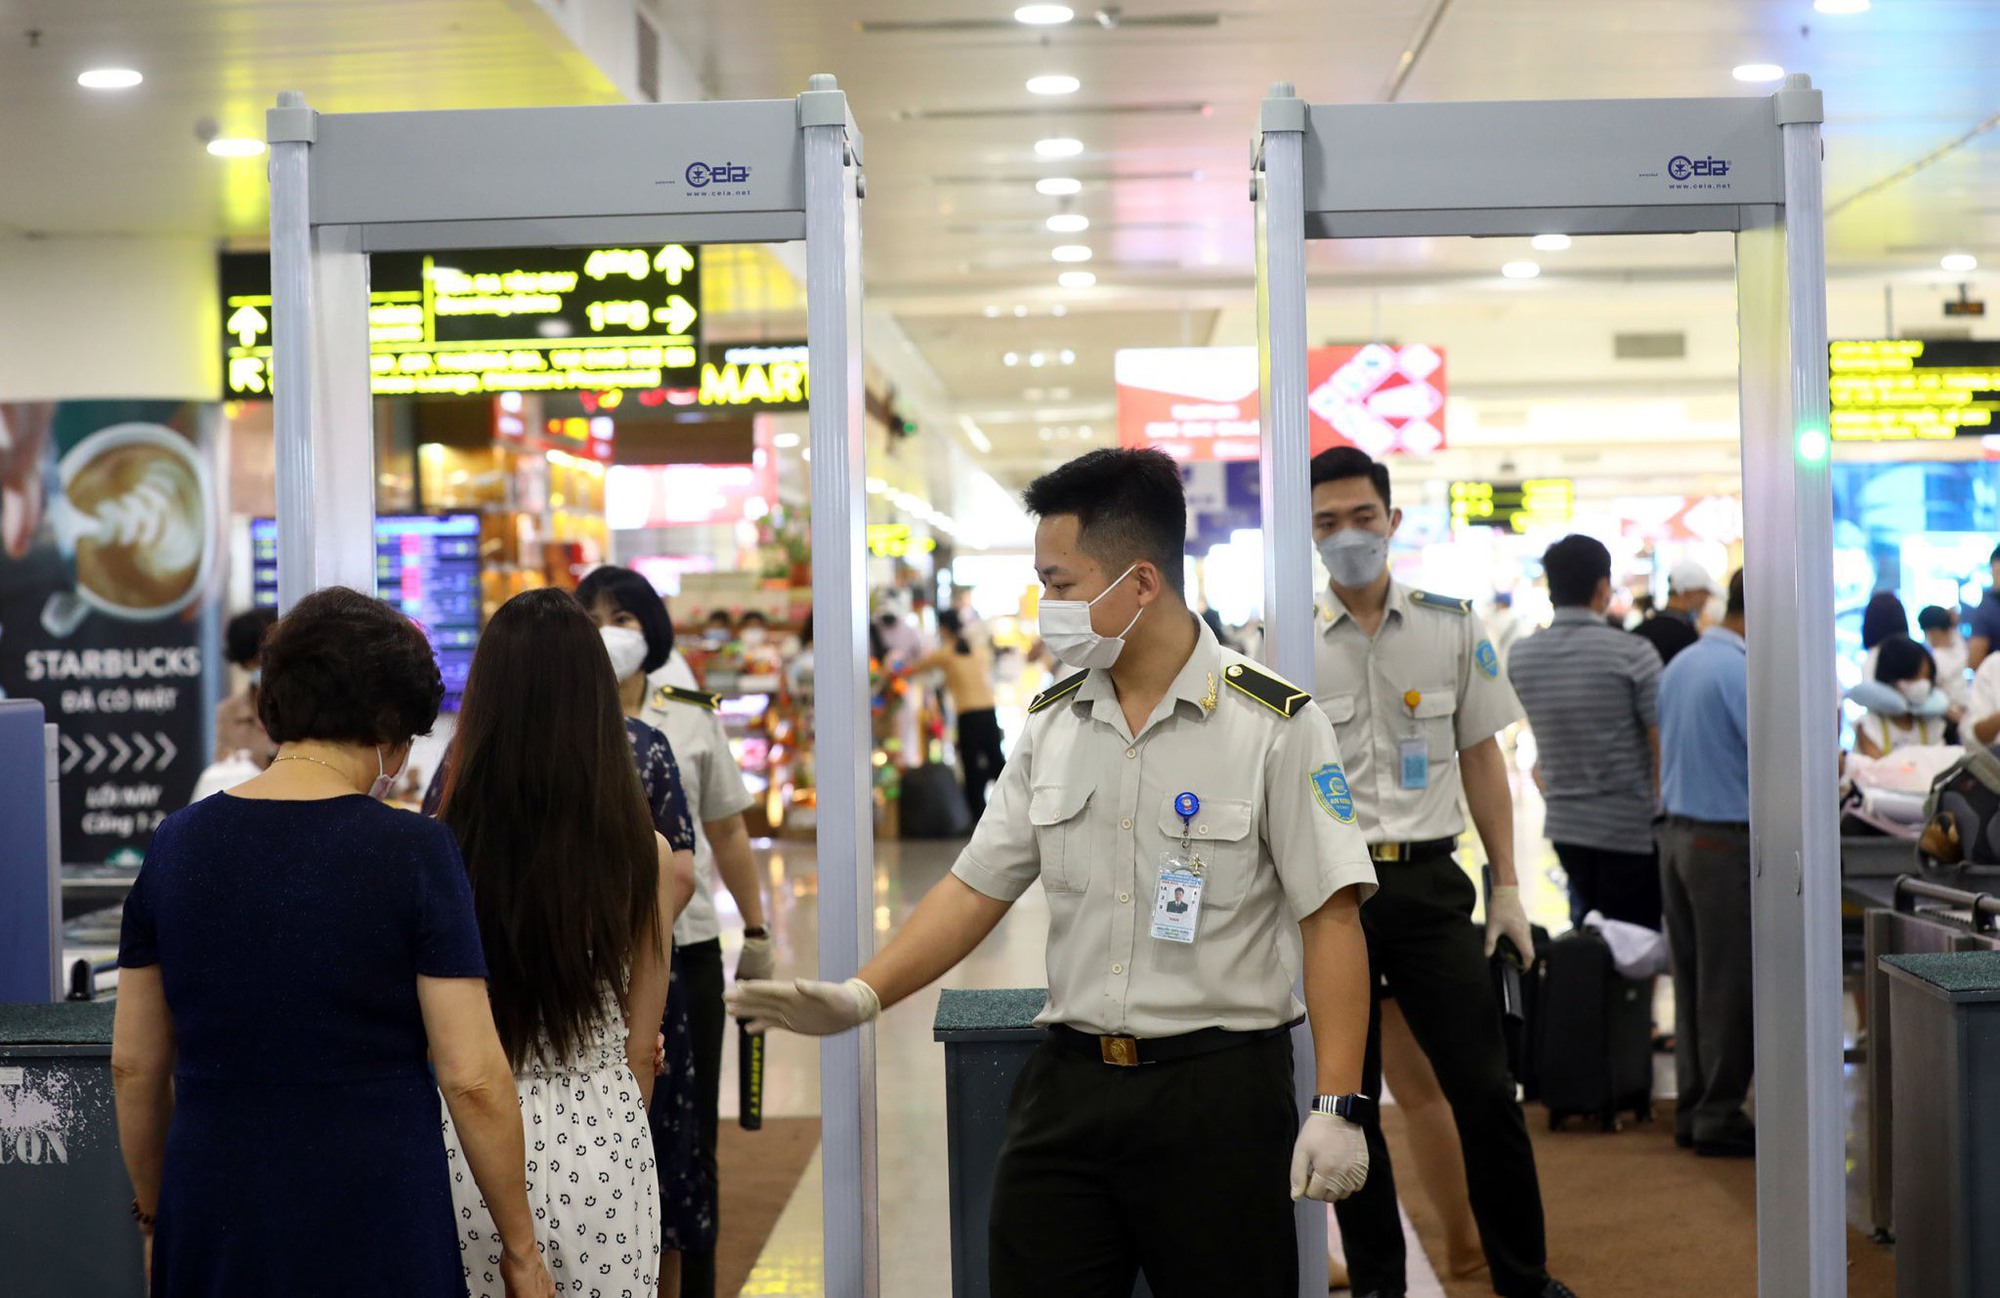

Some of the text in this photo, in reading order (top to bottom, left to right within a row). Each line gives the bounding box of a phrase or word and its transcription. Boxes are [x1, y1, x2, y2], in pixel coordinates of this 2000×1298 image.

[686, 189, 751, 197] www.ceia.net
[1668, 182, 1731, 190] www.ceia.net
[25, 647, 201, 680] STARBUCKS
[750, 1036, 760, 1116] GARRETT
